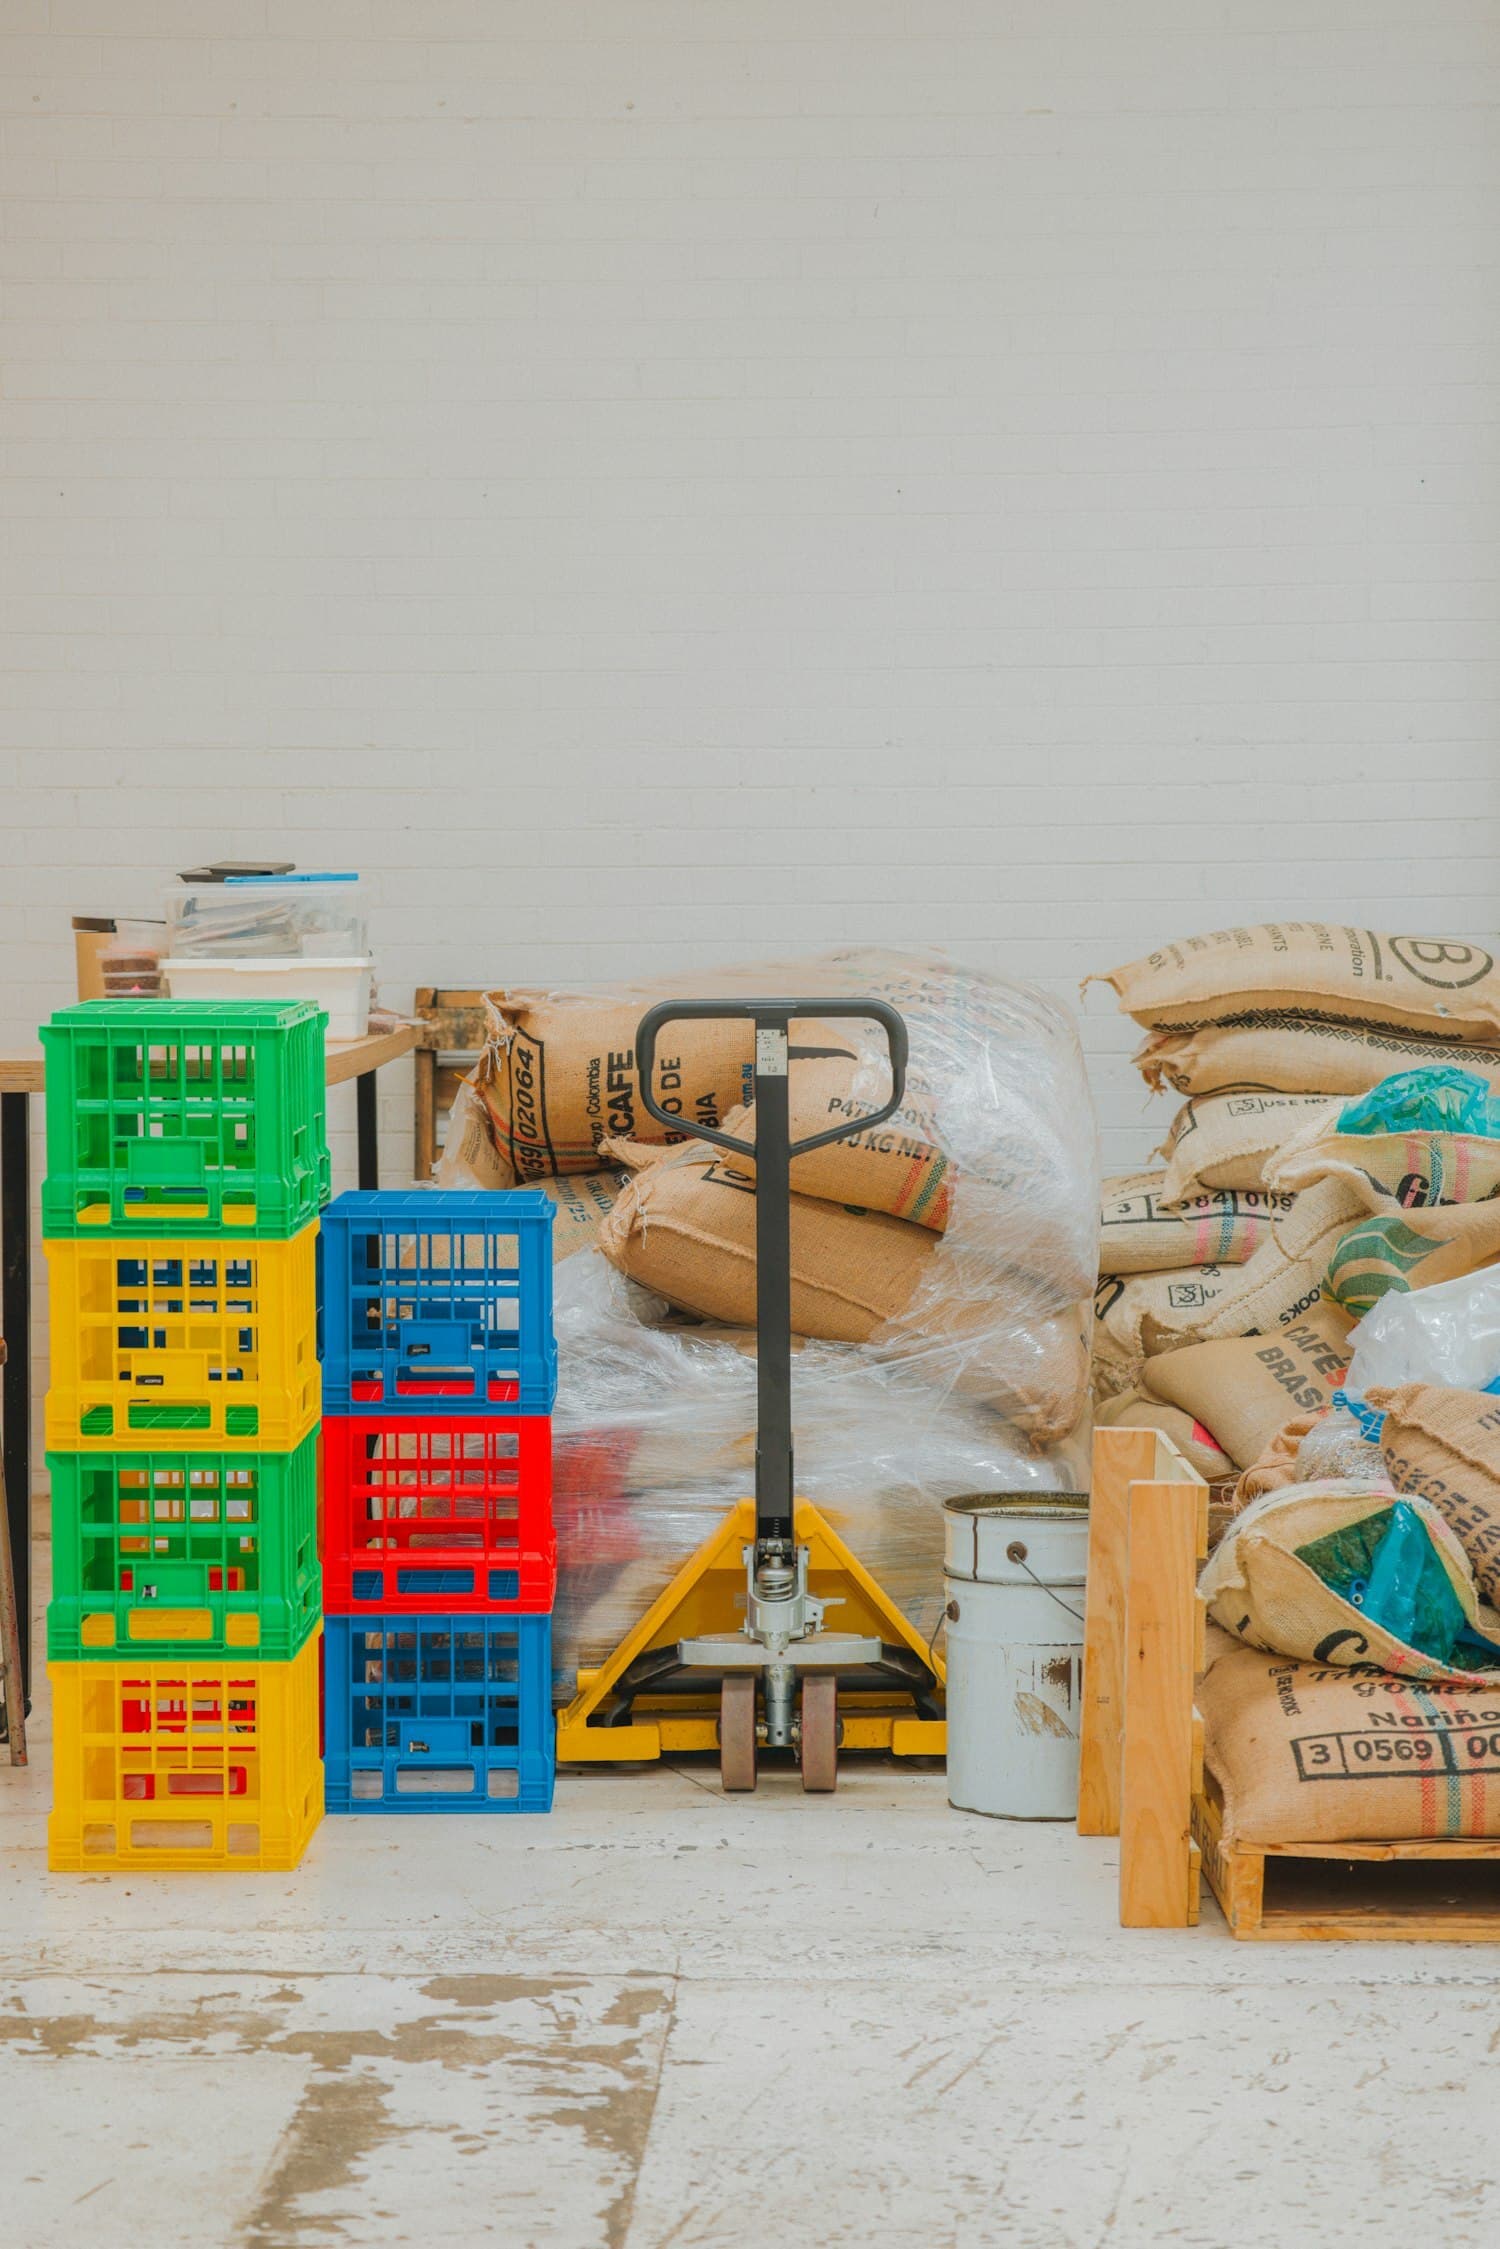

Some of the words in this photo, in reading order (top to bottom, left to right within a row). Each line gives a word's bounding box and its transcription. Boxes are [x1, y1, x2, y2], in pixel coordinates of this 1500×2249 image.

[661, 1057, 681, 1090] DE
[515, 1046, 538, 1139] 02064
[607, 1049, 634, 1137] CAFE
[864, 1131, 896, 1155] KG
[896, 1137, 936, 1163] NET
[1117, 1203, 1131, 1213] 3
[1279, 1283, 1321, 1326] OOKS
[1368, 1709, 1500, 1727] Nariño
[1309, 1743, 1331, 1764] 3
[1353, 1738, 1434, 1762] 0569
